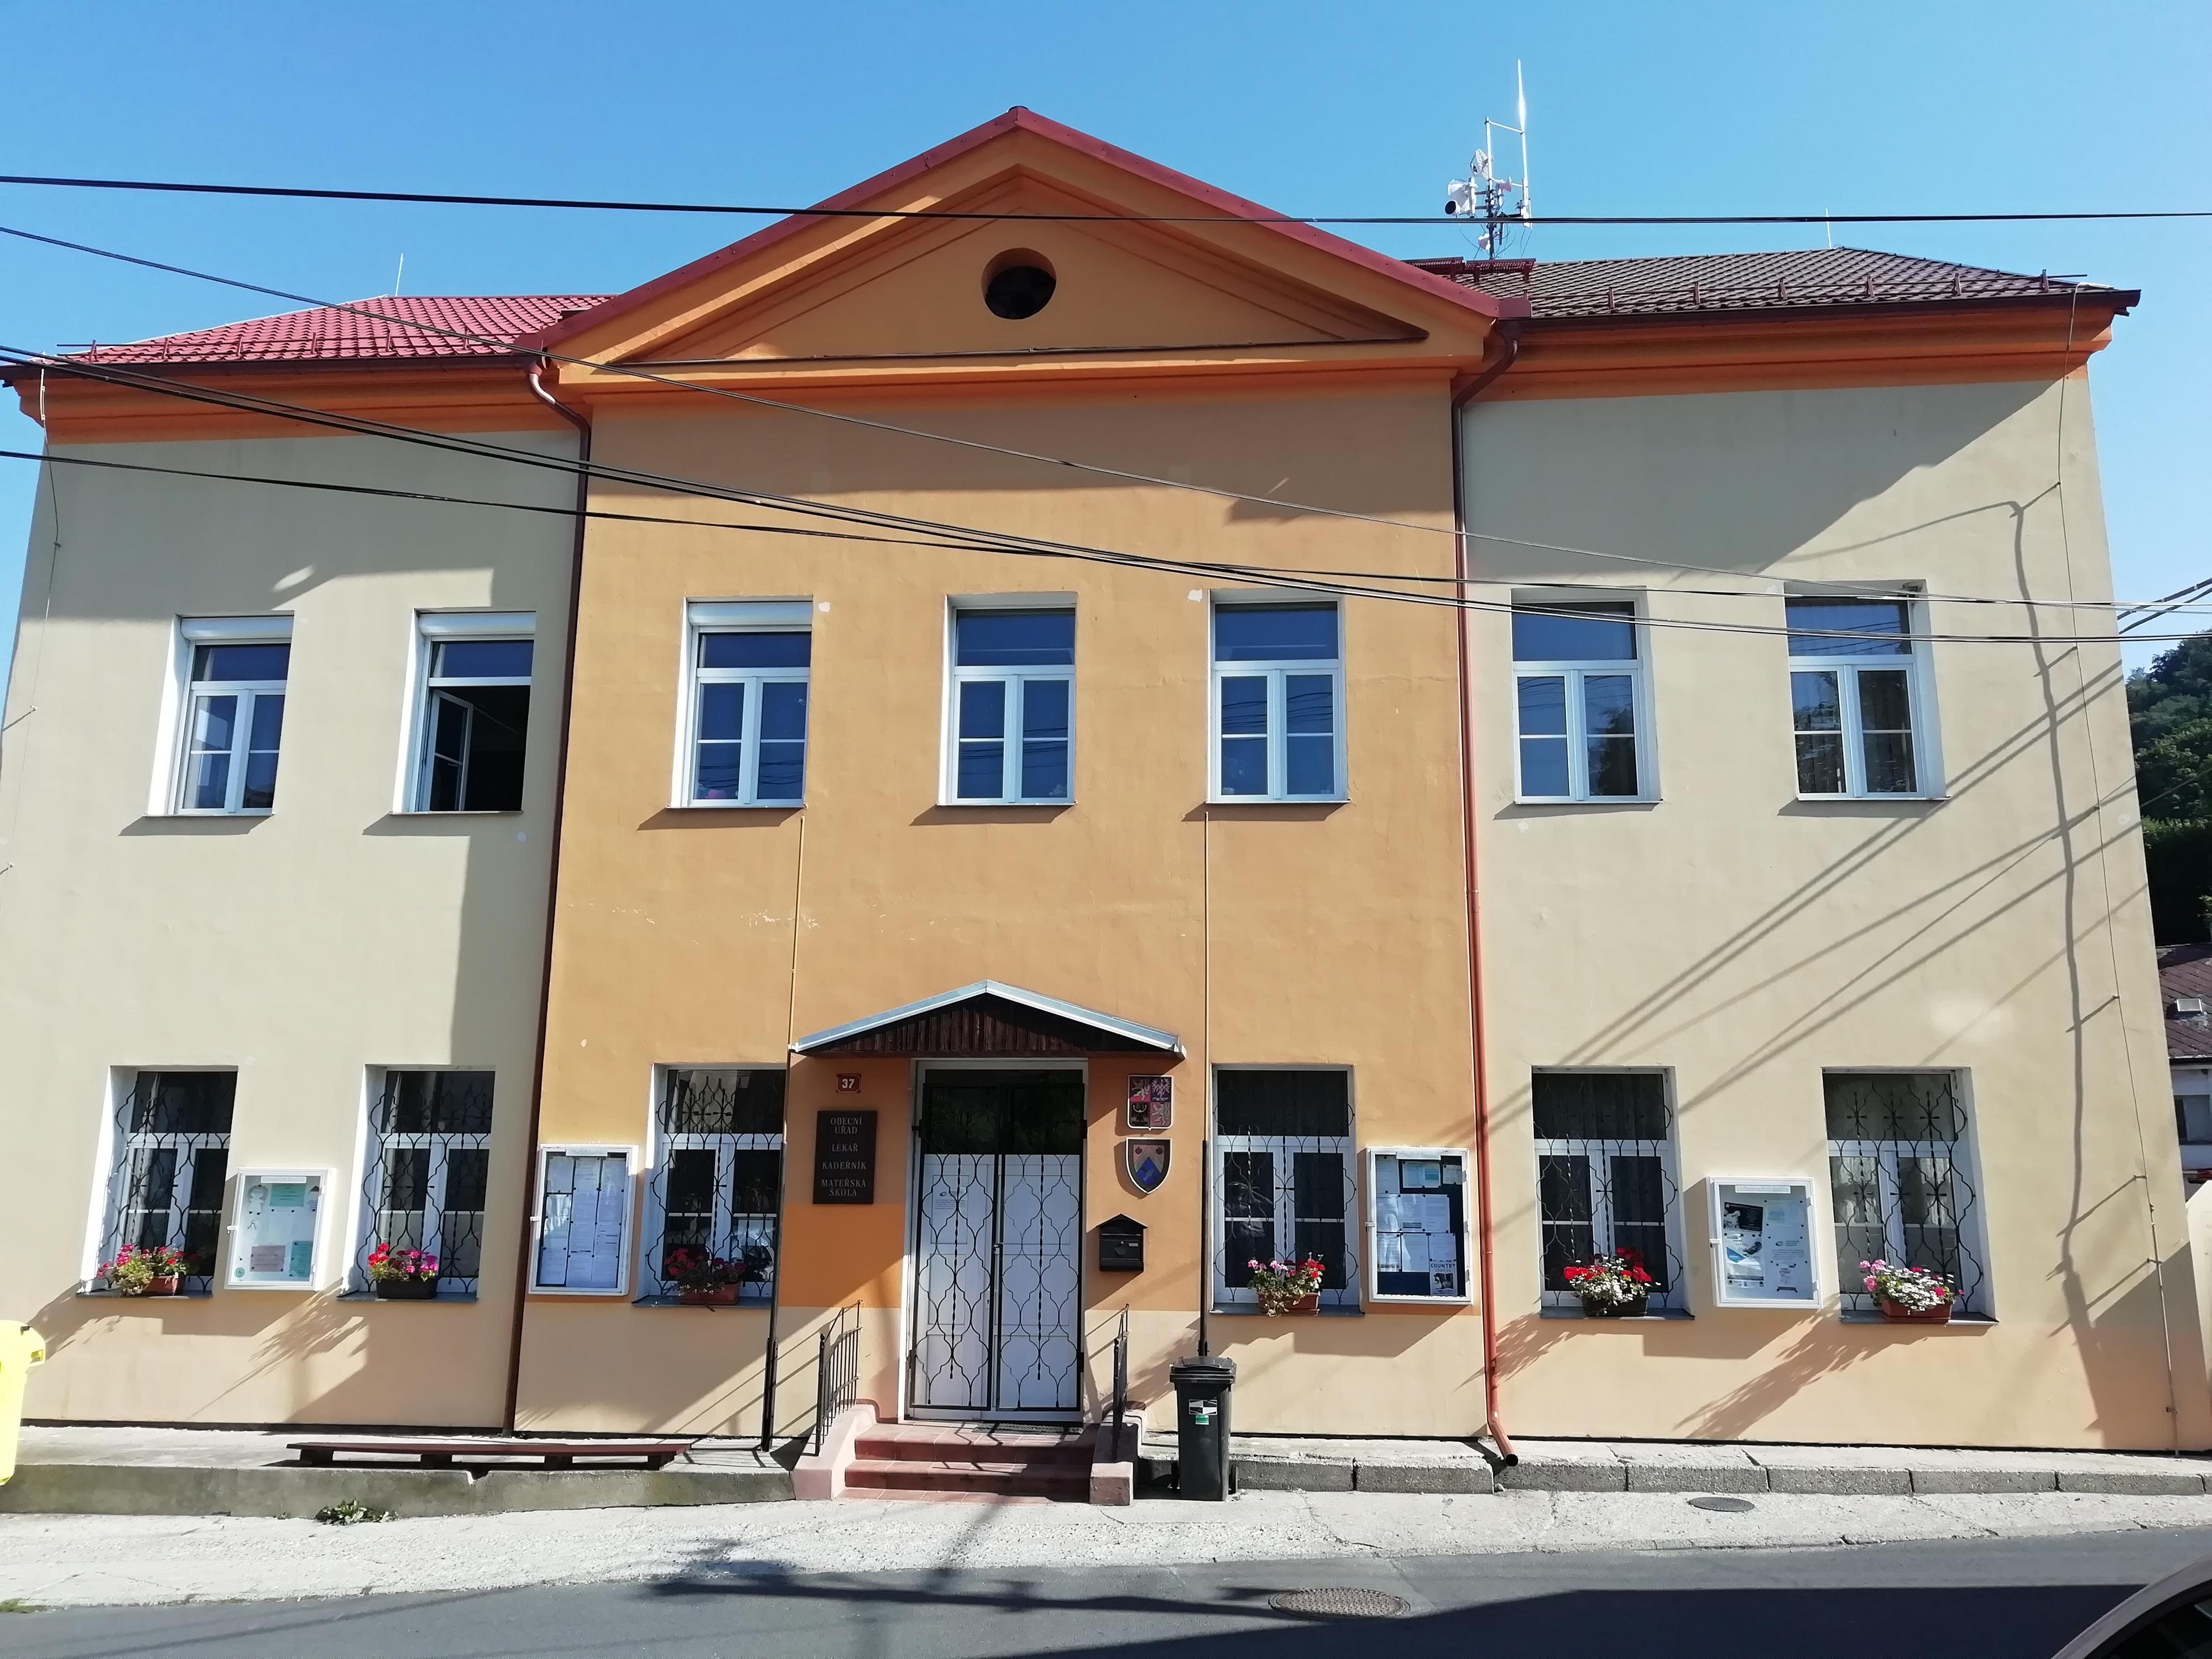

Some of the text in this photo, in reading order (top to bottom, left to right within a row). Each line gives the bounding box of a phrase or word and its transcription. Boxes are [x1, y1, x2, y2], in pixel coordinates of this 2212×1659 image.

[842, 1078, 854, 1088] 37
[831, 1115, 862, 1125] OBECNÍ
[832, 1142, 859, 1152] LÉKAŘ
[822, 1160, 867, 1170] KADEŘNÍK
[821, 1178, 866, 1188] MATEŘSKÁ
[828, 1187, 857, 1197] ŠKOLA
